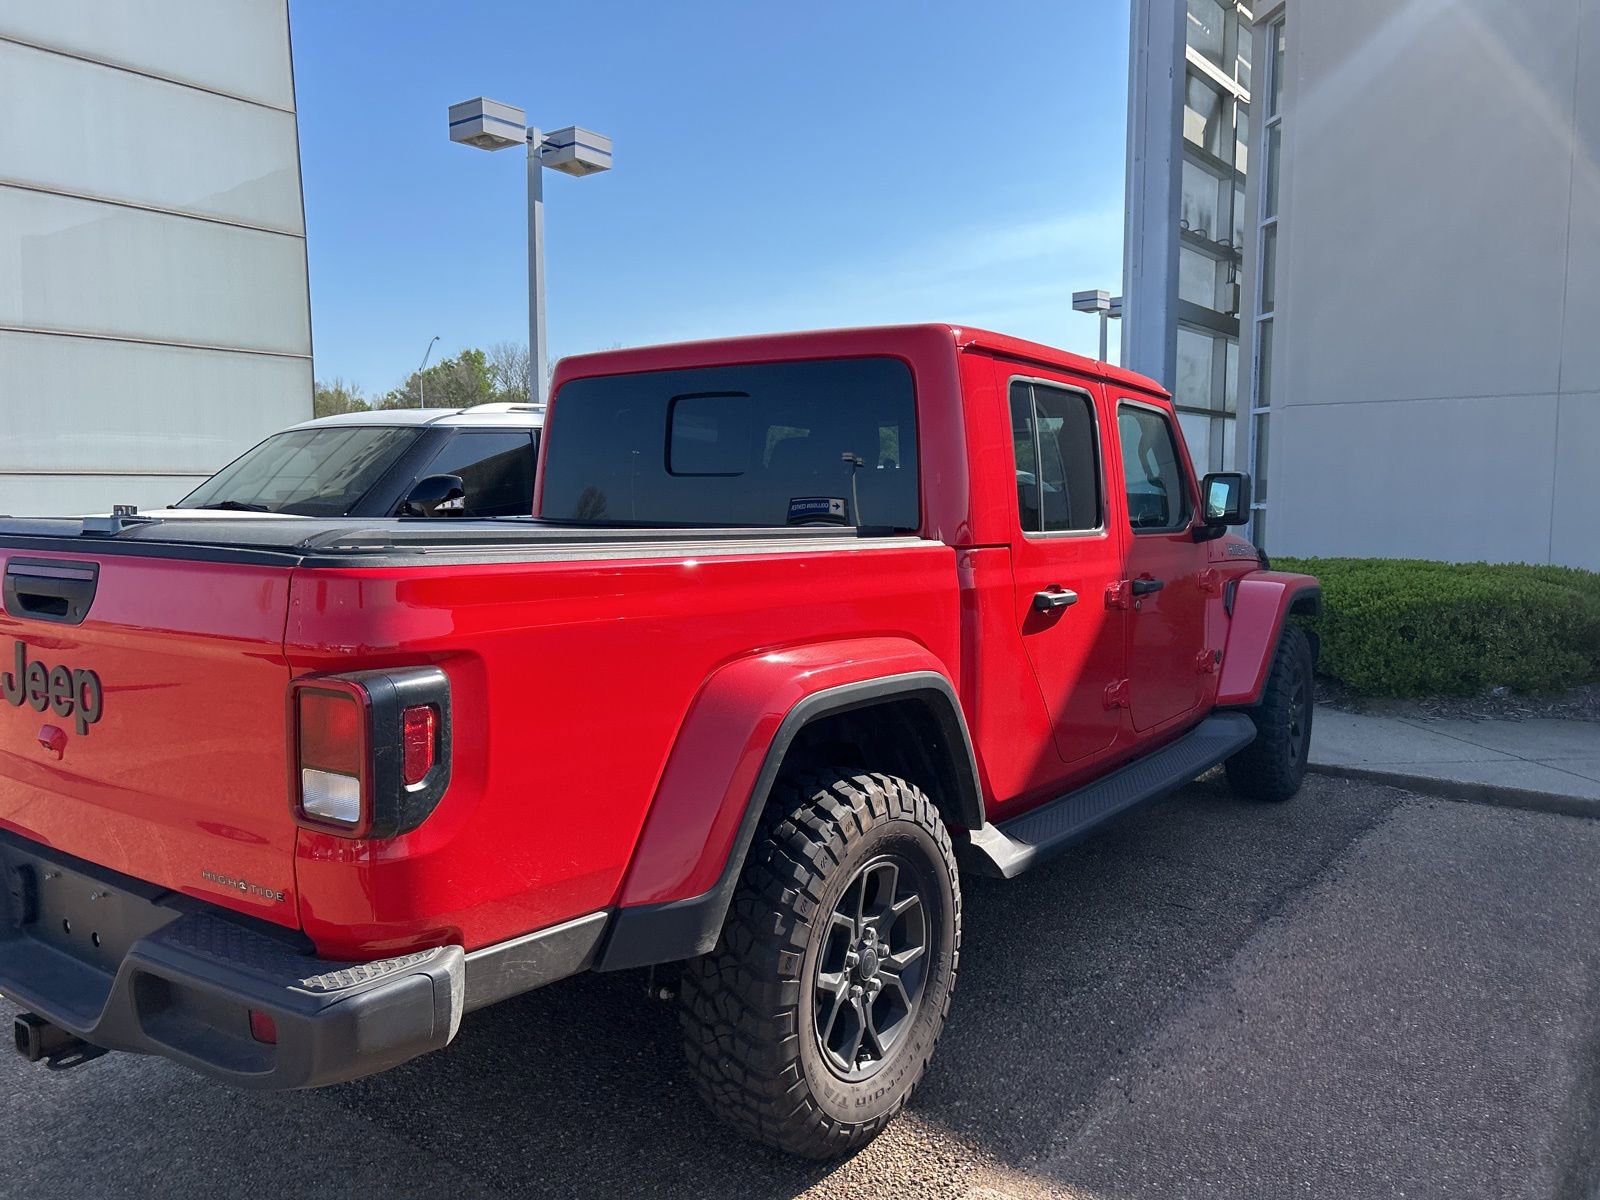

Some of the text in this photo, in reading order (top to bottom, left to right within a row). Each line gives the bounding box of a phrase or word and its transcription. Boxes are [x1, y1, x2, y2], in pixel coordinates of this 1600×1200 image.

[2, 640, 104, 736] Jeep
[202, 870, 285, 902] HIGH TIDE
